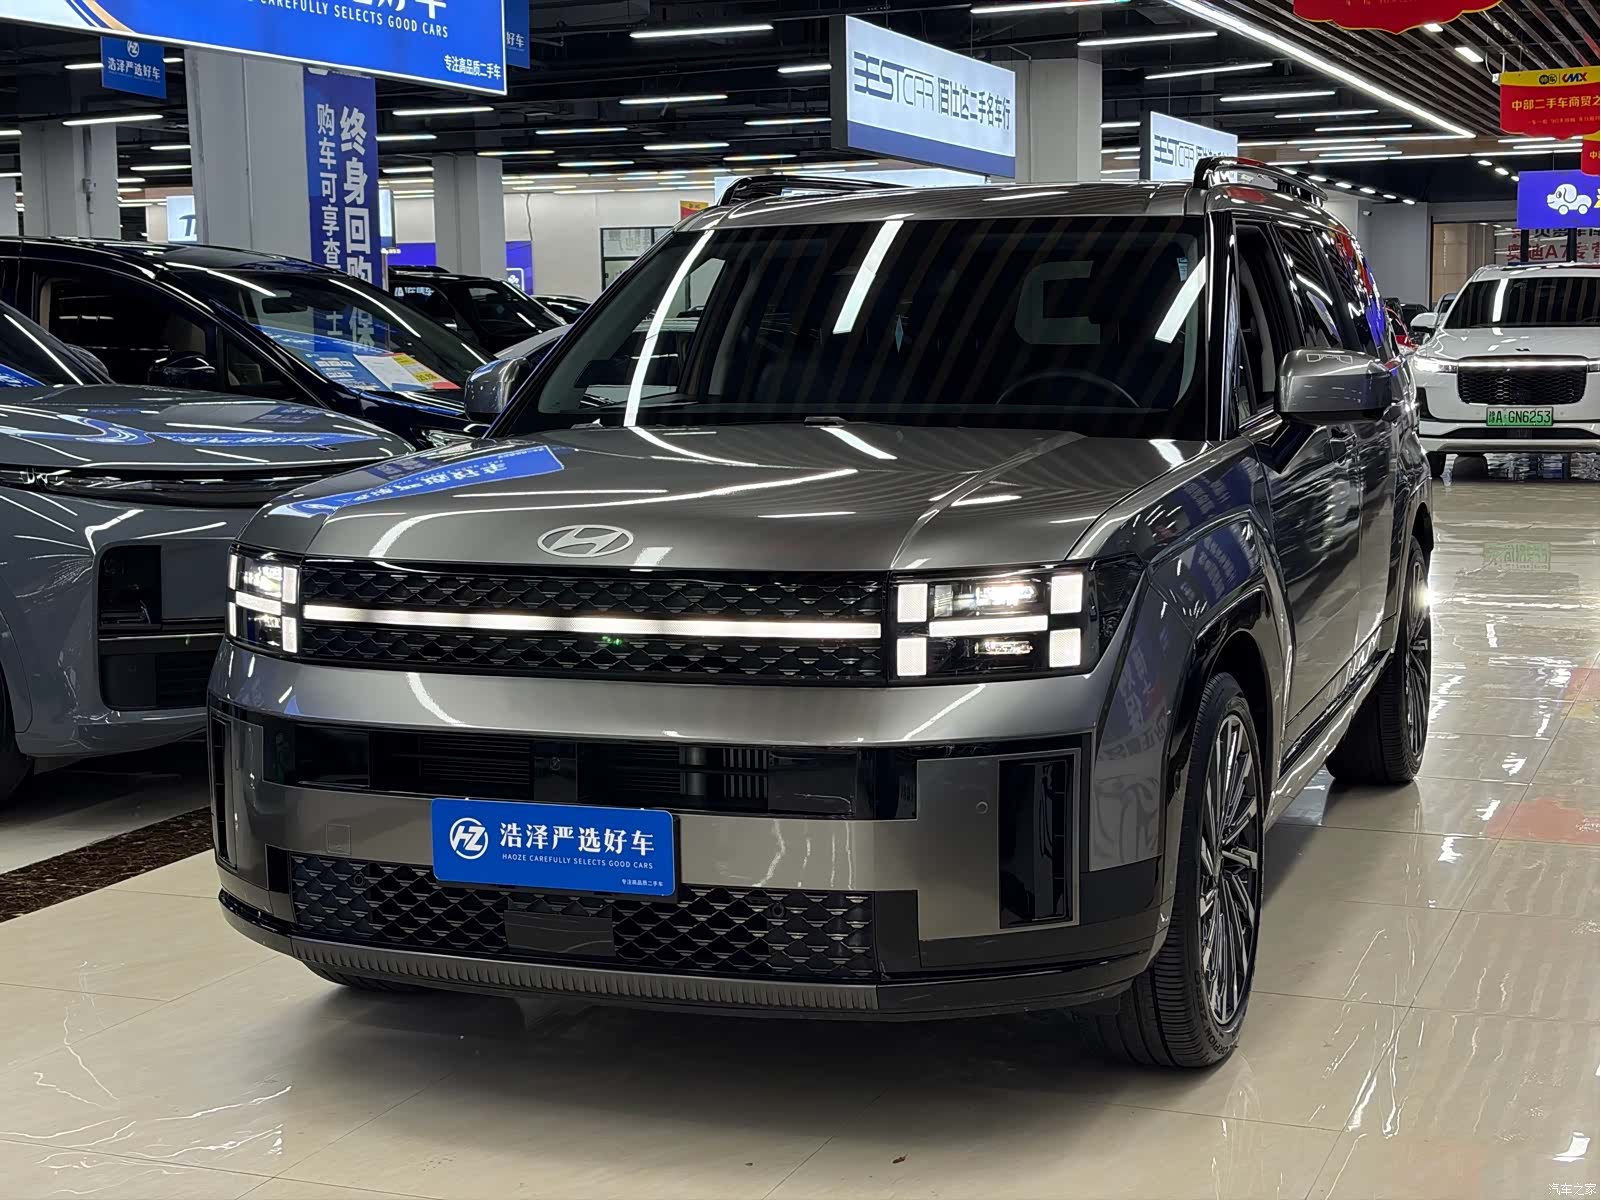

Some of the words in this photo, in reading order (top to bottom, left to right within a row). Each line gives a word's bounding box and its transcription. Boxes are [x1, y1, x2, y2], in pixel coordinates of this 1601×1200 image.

[334, 4, 383, 25] SELECTS
[388, 15, 417, 32] GOOD
[422, 22, 448, 38] CARS
[444, 54, 501, 80] 专注高品质二手车
[1508, 410, 1551, 424] GN6253
[500, 822, 655, 856] 浩泽严选好车
[502, 853, 527, 862] HAOZE
[529, 855, 571, 864] CAREFULLY
[573, 857, 606, 867] SELECTS
[608, 860, 631, 868] GOOD
[633, 861, 653, 870] CARS
